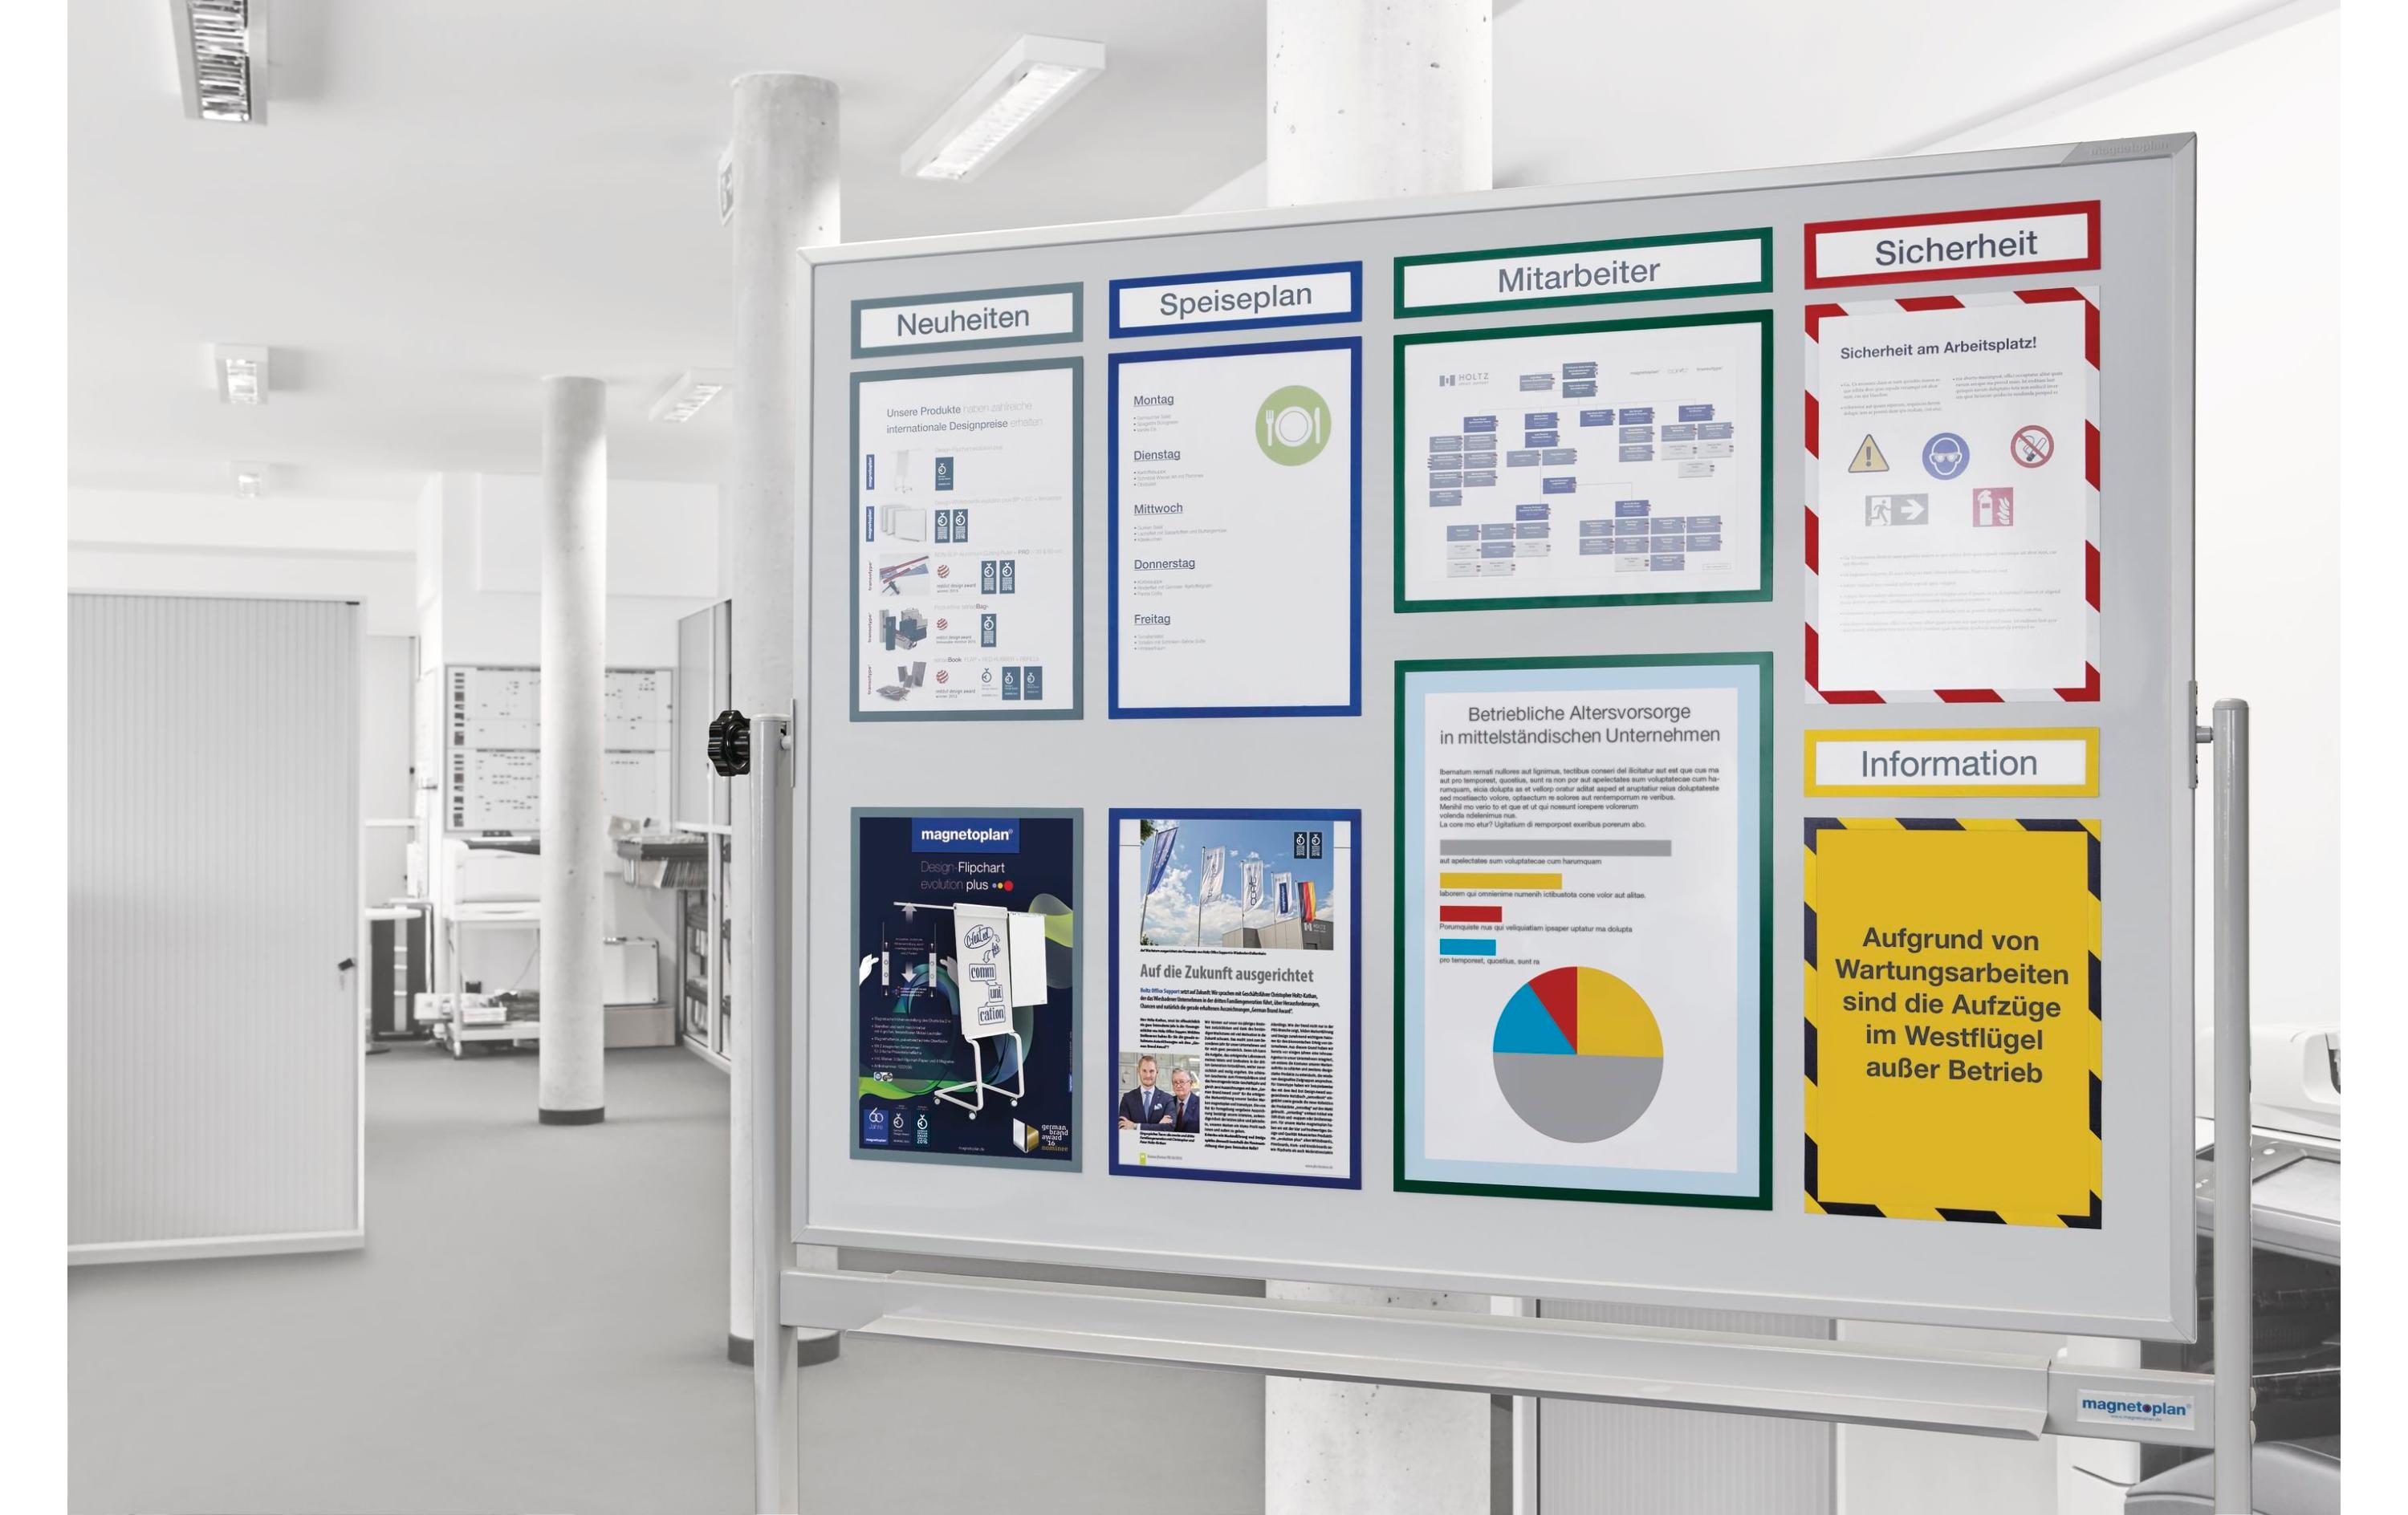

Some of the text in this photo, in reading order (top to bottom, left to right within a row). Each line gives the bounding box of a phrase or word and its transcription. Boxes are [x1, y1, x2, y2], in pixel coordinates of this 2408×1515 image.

[1876, 230, 2037, 266] Sicherheit
[1499, 261, 1660, 292] Mitarbeiter
[1160, 285, 1312, 320] Speiseplan
[897, 307, 1029, 336] Neuheiten
[1841, 337, 2036, 359] Sicherheit am Arbeitsplatz!
[1134, 395, 1174, 405] Montag
[887, 407, 919, 417] Unsere
[920, 405, 960, 415] Produkte
[887, 422, 946, 433] internationale
[948, 420, 1007, 432] Designpreise
[1134, 450, 1180, 460] Dienstag
[1134, 503, 1182, 514] Mittwoch
[1134, 559, 1195, 569] Donnerstag
[1134, 614, 1170, 625] Freitag
[1468, 706, 1691, 723] Betriebliche Altersvorsorge
[1440, 728, 1720, 744] in mittelständischen Unternehmen
[1862, 750, 2037, 777] Information
[921, 879, 988, 892] evolution plus
[1862, 927, 2039, 953] Aufgrund von
[971, 967, 994, 978] comm
[1140, 964, 1314, 984] Auf die Zukunft ausgerichtet
[1835, 959, 2068, 986] Wartungsarbeiten
[980, 1008, 1004, 1022] cation
[1843, 992, 2061, 1022] sind die Aufzüge
[1866, 1024, 2043, 1054] im Westflügel
[1866, 1058, 2043, 1083] außer Betrieb
